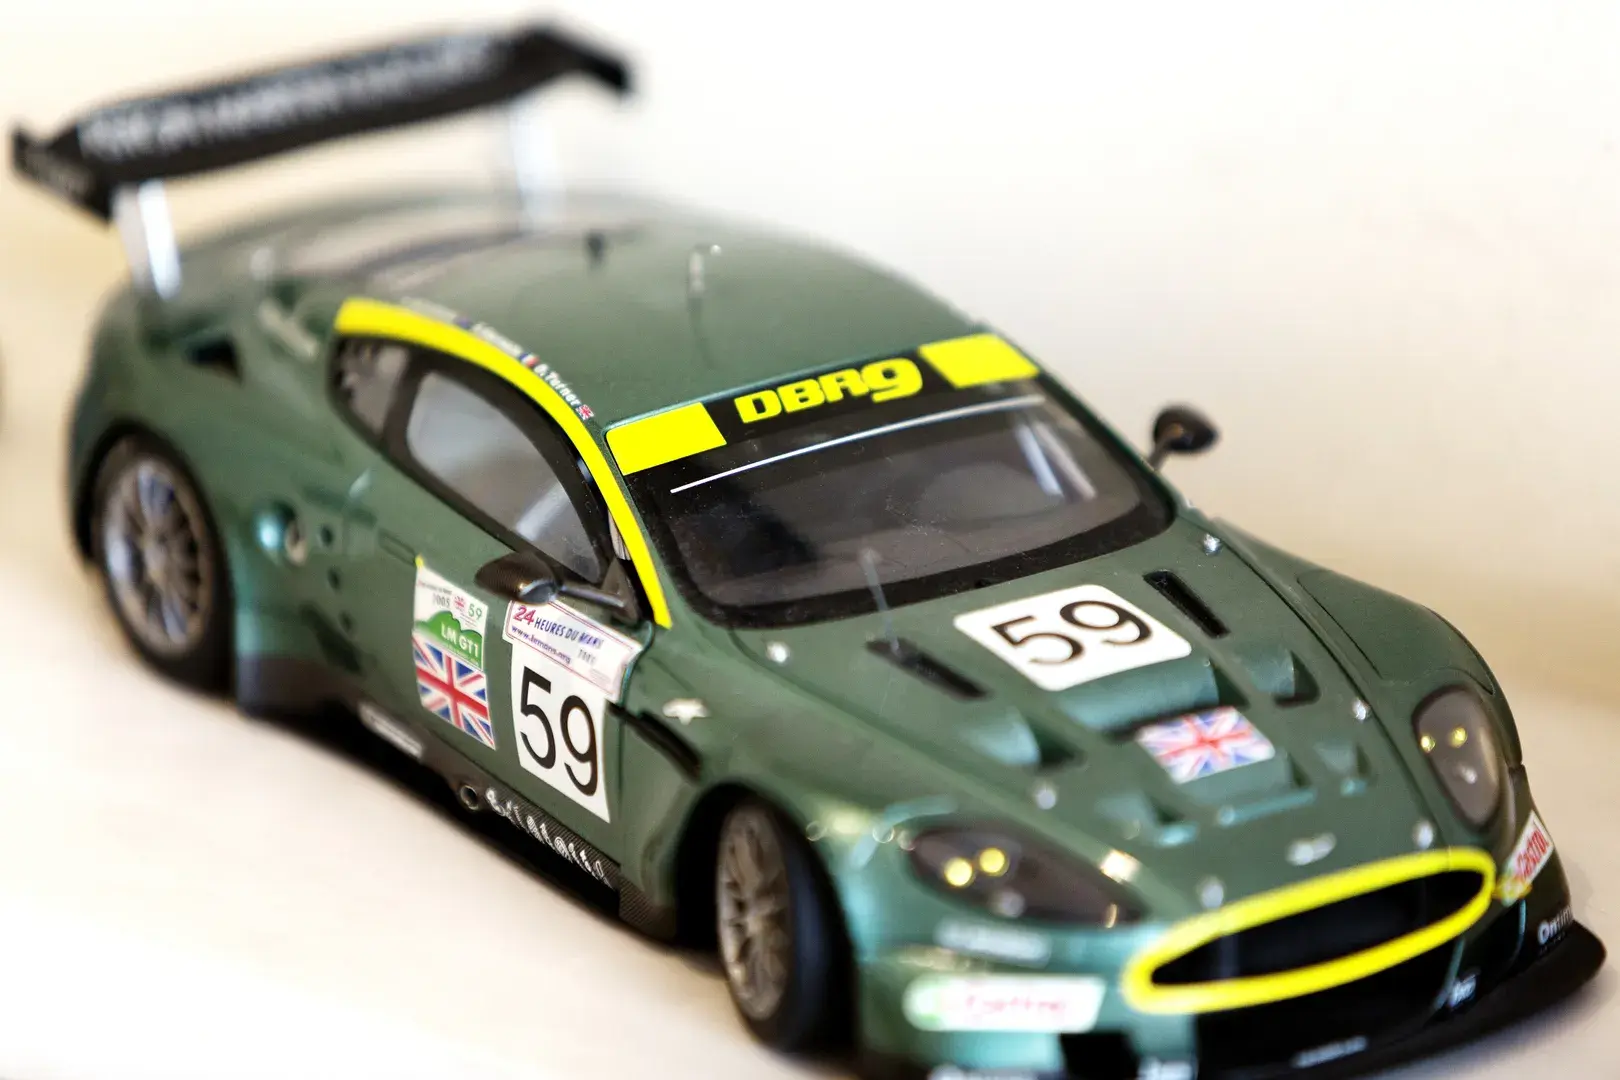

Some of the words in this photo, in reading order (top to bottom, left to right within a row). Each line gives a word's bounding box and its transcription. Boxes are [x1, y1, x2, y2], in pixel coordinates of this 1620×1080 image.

[734, 358, 923, 424] DBR9
[441, 621, 458, 645] LM
[467, 602, 483, 619] 59
[513, 605, 537, 625] 24
[534, 617, 566, 637] HEURES
[565, 627, 579, 641] DU
[989, 600, 1153, 666] 59
[520, 665, 598, 797] 59
